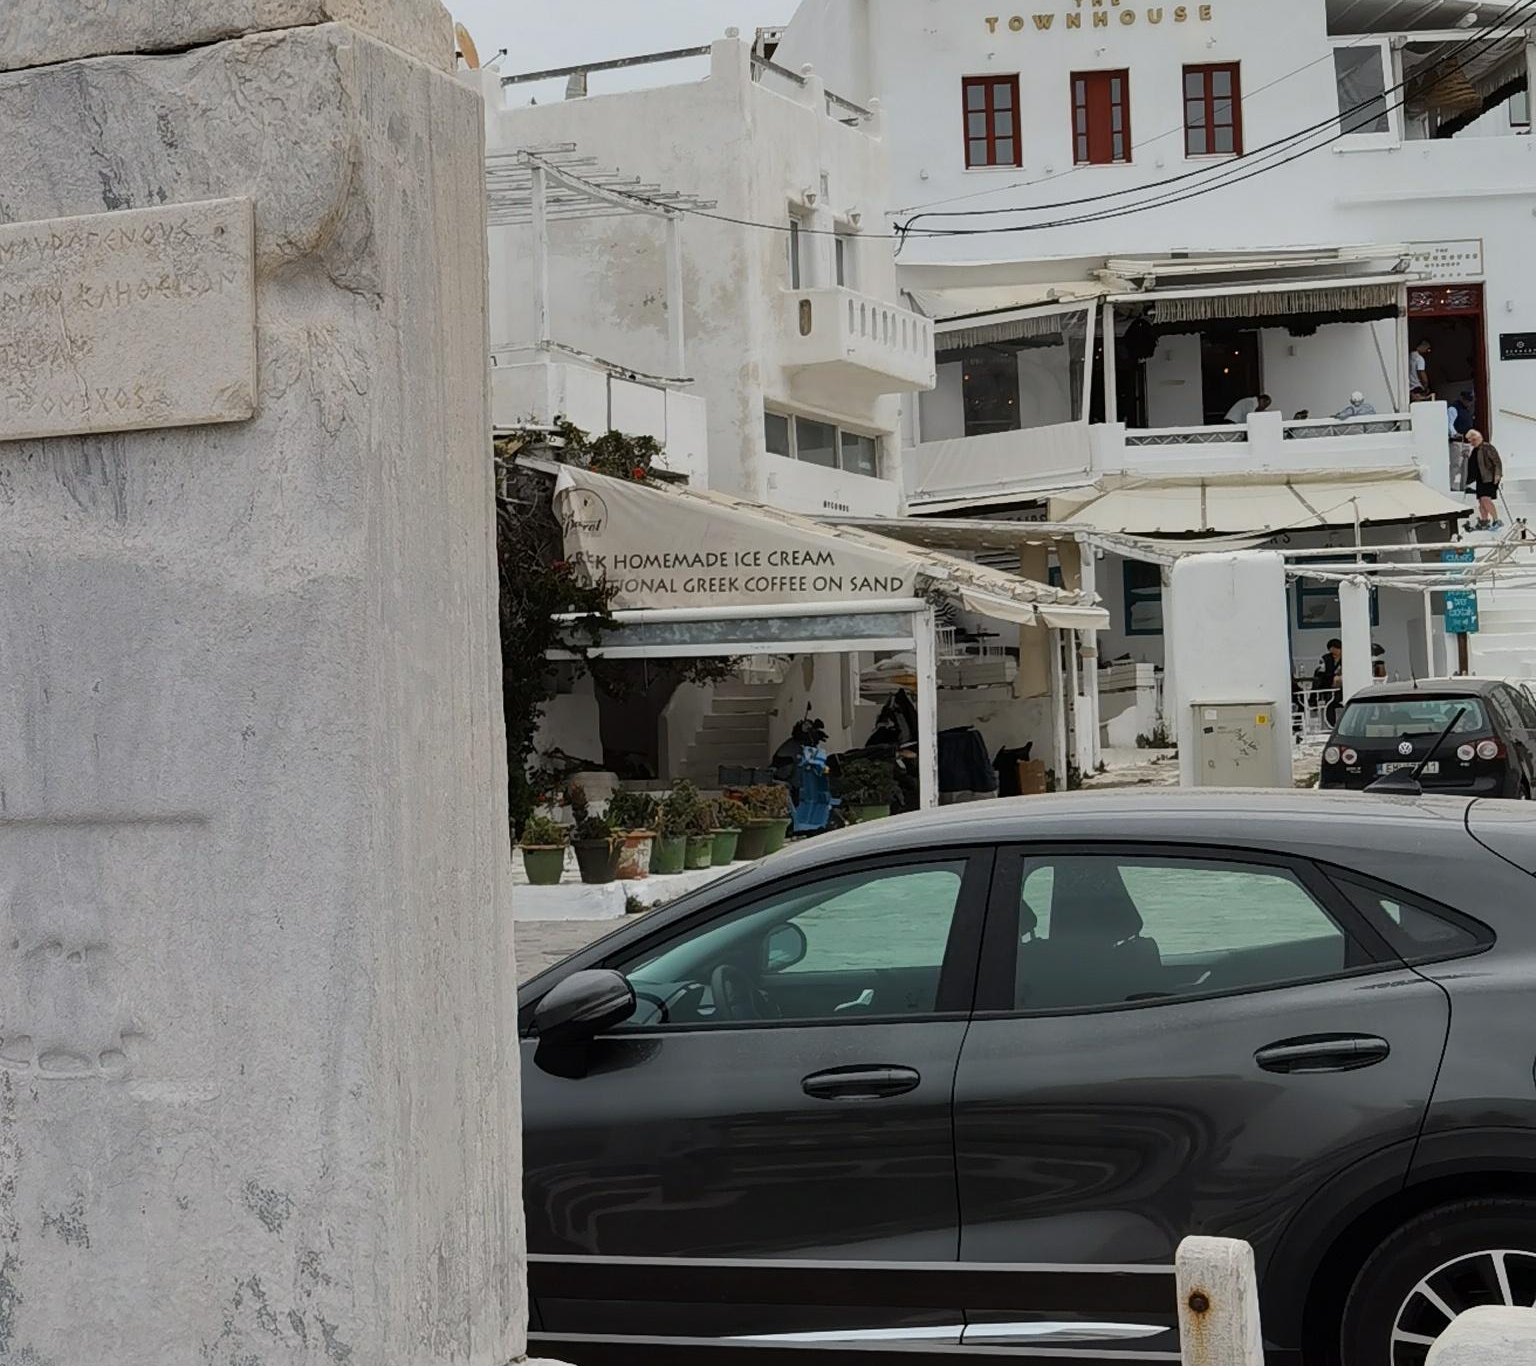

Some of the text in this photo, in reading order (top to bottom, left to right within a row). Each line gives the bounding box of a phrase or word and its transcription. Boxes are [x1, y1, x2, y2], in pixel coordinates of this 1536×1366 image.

[985, 4, 1212, 34] TOWNHOUSE
[614, 552, 728, 570] HOMEMADE
[735, 551, 761, 568] ICE
[767, 550, 835, 567] CREAM
[683, 577, 739, 593] GREEK
[744, 576, 807, 592] COFFEE
[813, 576, 842, 592] ON
[850, 576, 904, 592] SAND
